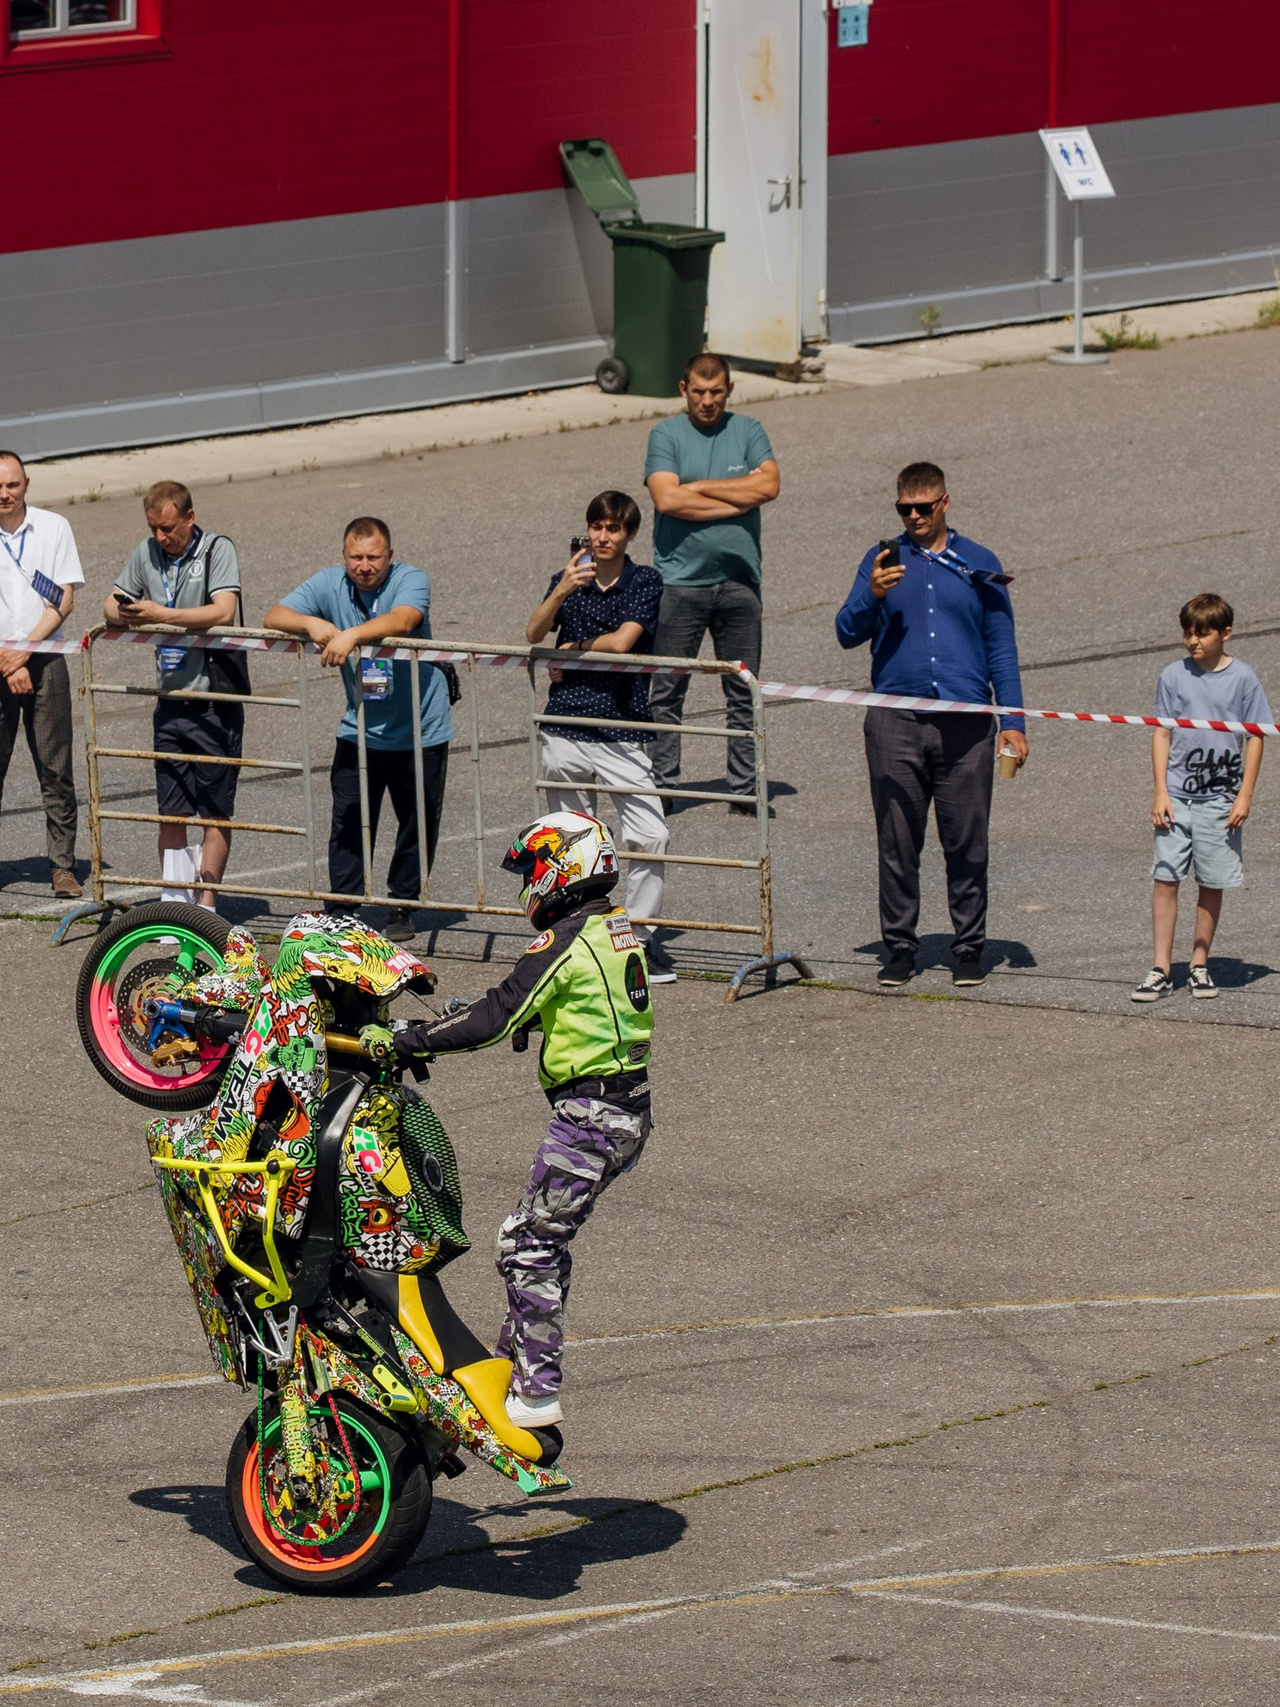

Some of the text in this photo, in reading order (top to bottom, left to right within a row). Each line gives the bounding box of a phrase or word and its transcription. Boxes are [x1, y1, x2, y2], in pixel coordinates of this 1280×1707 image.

[1078, 178, 1094, 186] WC
[214, 1059, 254, 1141] TEAM
[352, 1157, 379, 1193] TEAM
